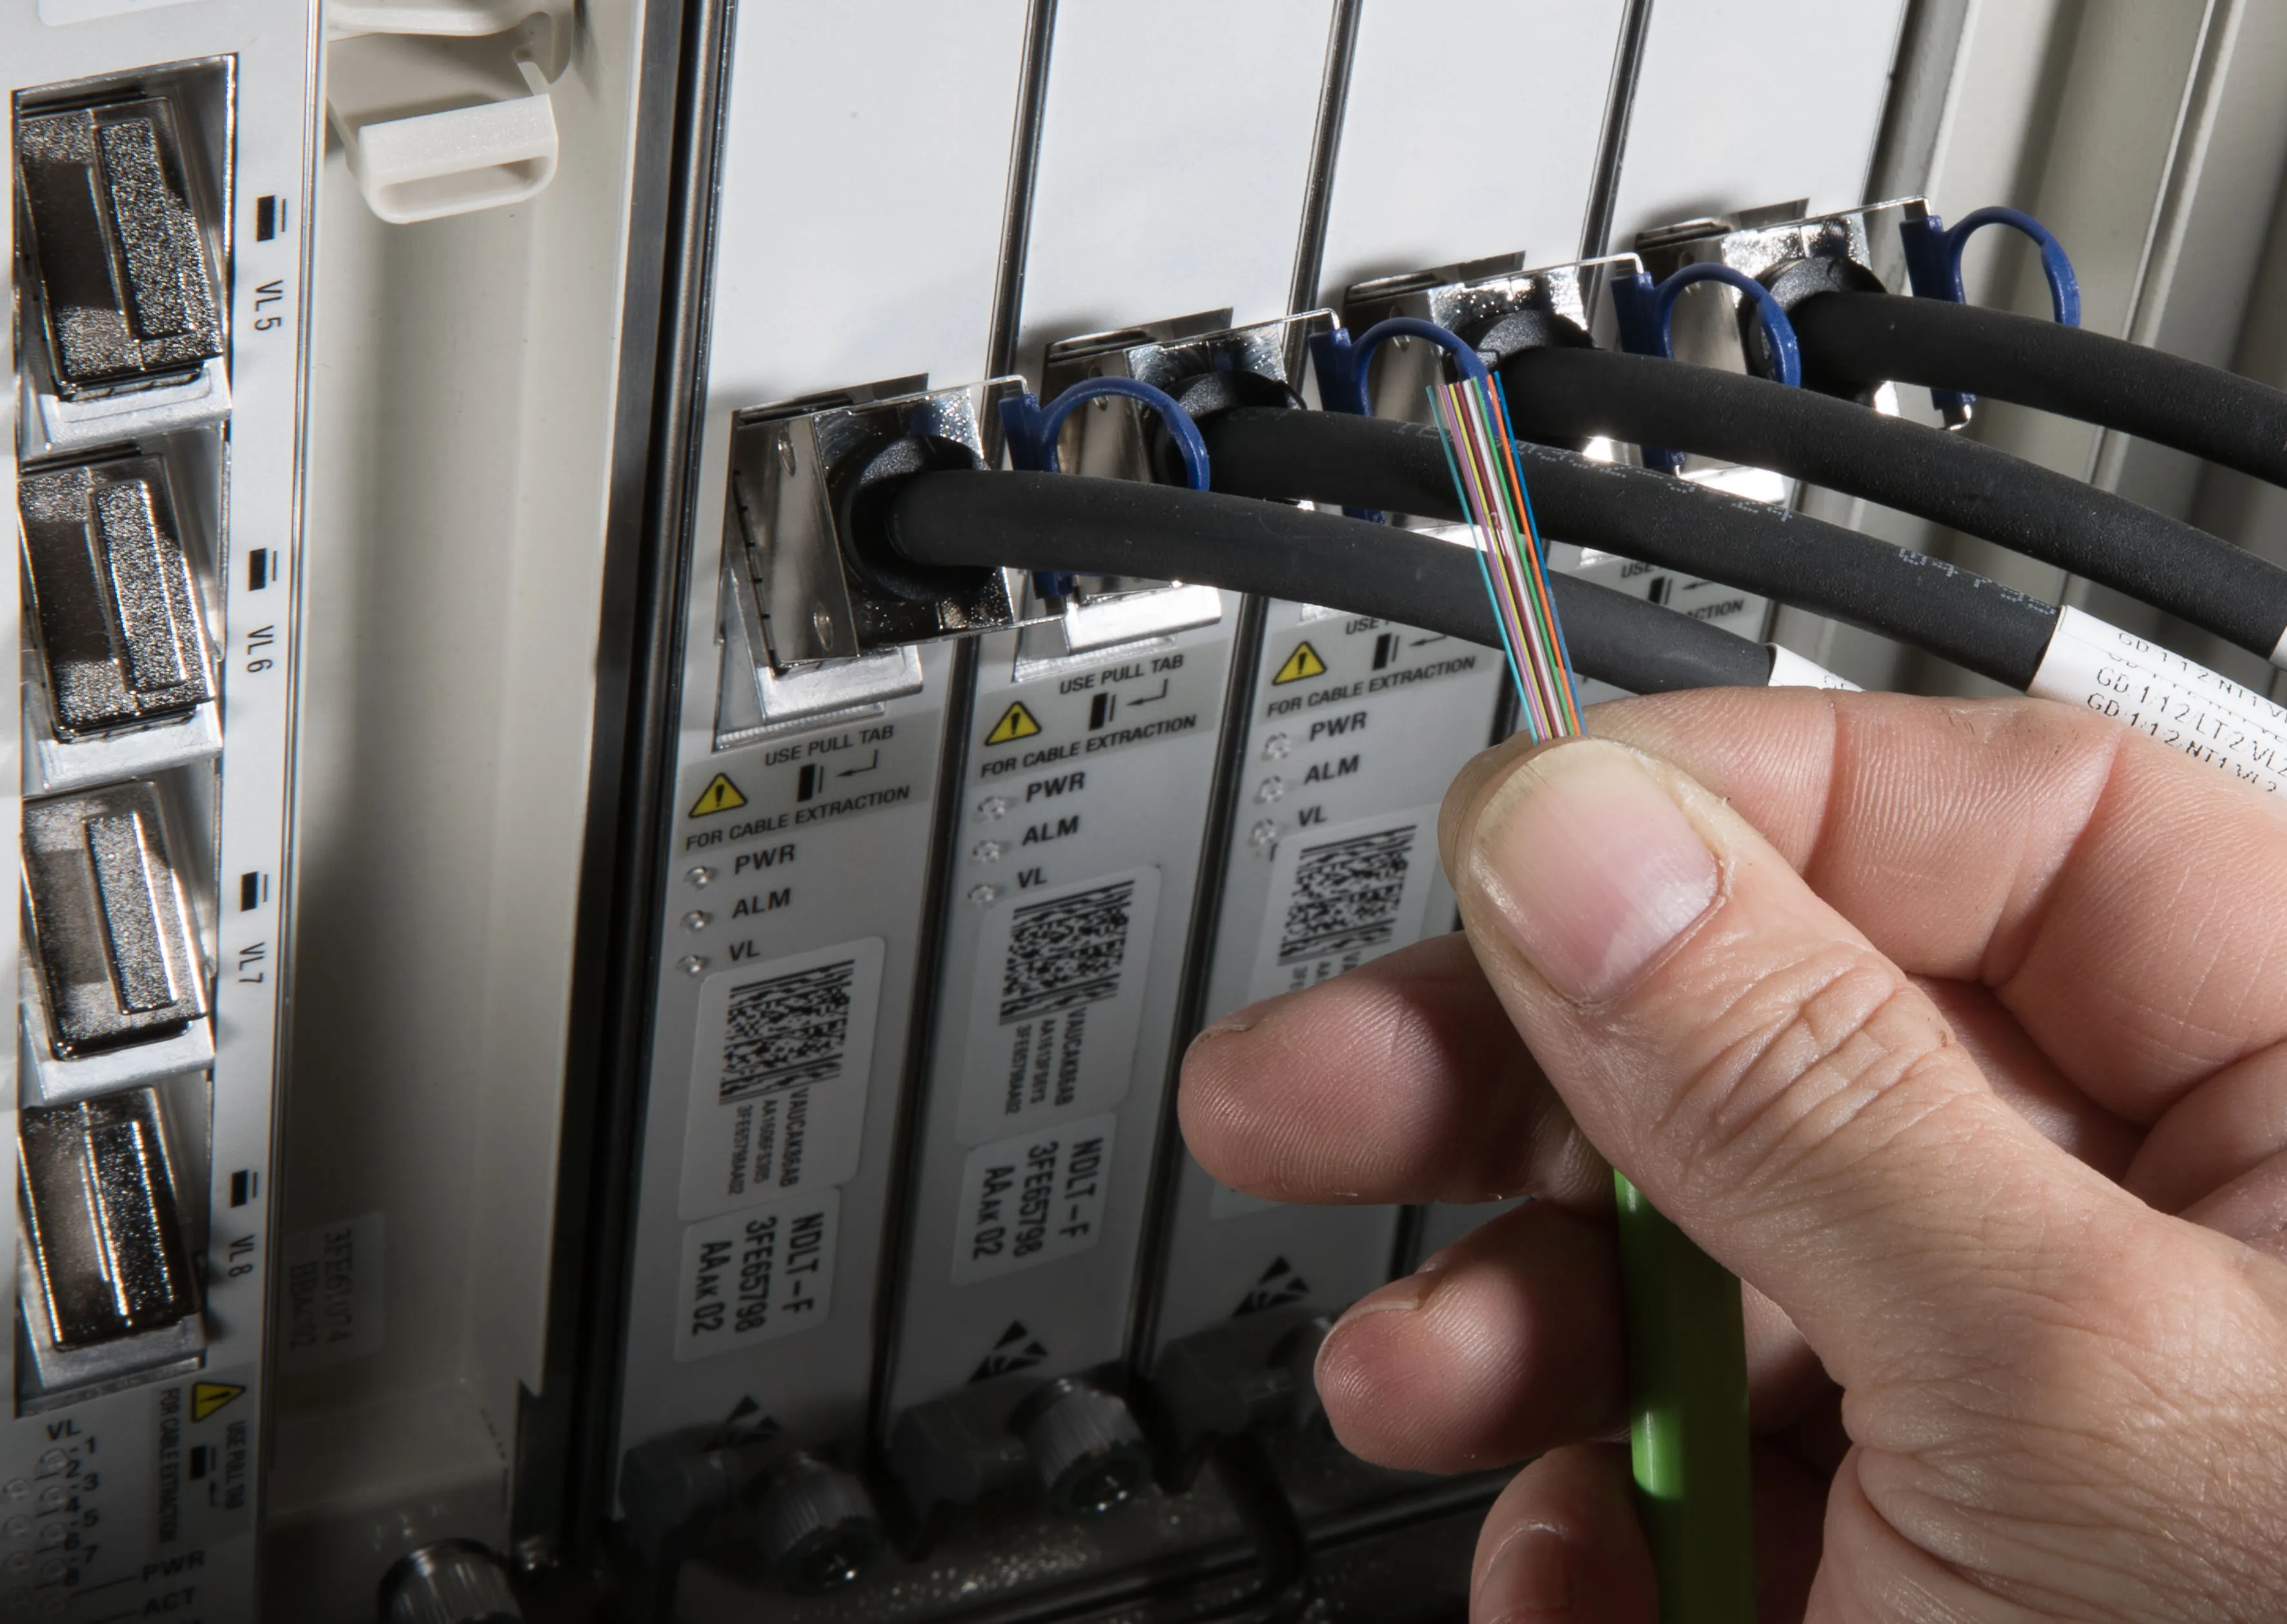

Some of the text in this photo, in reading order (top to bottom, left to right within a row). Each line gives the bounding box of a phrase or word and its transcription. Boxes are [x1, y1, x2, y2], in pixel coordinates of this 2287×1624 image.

[254, 279, 283, 332] VL5
[1346, 616, 1379, 635] USE
[245, 624, 276, 675] VL6
[1059, 653, 1184, 695] USE PULL TAB
[1266, 655, 1476, 718] FOR CABLE EXTRACTION
[1309, 711, 1367, 742] PWR
[765, 725, 895, 767] USE PULL TAB
[981, 715, 1196, 778] FOR CABLE EXTRACTION
[1305, 755, 1360, 785] ALM
[1026, 772, 1086, 804] PWR
[685, 786, 910, 851] FOR CABLE EXTRACTION
[1022, 815, 1079, 847] ALM
[1298, 805, 1327, 828] VL
[734, 844, 795, 875] PWR
[1017, 868, 1048, 890] VL
[731, 888, 792, 920] ALM
[238, 942, 265, 984] VL7
[729, 939, 760, 963] VL
[1013, 1141, 1059, 1257] 3FE65798
[228, 1235, 254, 1279] VL8
[735, 1216, 777, 1334] 3FE65798
[159, 1388, 181, 1416] FOR
[47, 1418, 81, 1441] VL
[159, 1417, 180, 1461] CABLE
[142, 1550, 205, 1582] PWR
[142, 1587, 196, 1618] ACT
